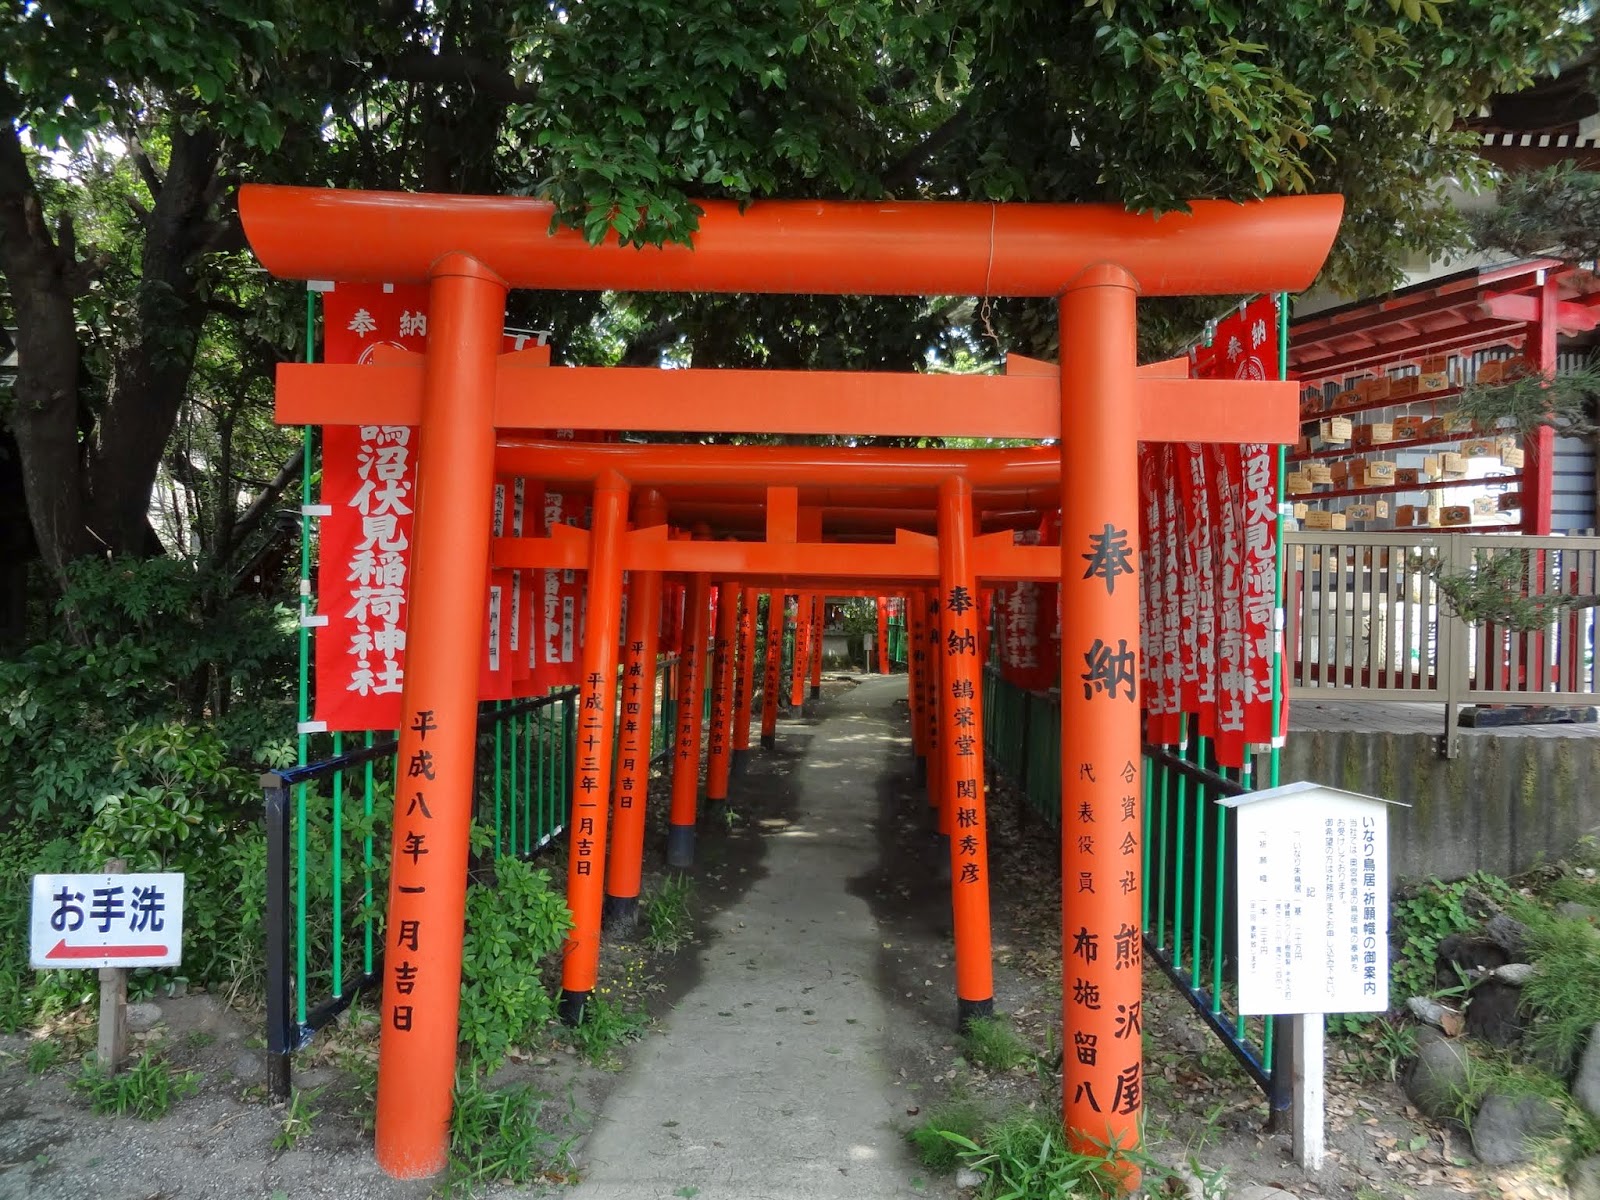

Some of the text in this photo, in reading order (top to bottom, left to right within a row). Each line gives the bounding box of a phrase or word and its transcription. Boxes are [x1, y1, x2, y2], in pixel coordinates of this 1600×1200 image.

[347, 308, 427, 338] 奉納
[945, 585, 977, 657] 奉納
[1082, 524, 1135, 703] 奉納
[576, 672, 605, 876] 平成二十三年一月吉日
[620, 641, 645, 810] 平成十四年二月吉日
[50, 885, 166, 933] お手洗
[392, 710, 438, 1032] 平成八年一月吉日
[1077, 763, 1097, 894] 代表役員
[1111, 760, 1141, 1116] 合資会社 熊沢屋
